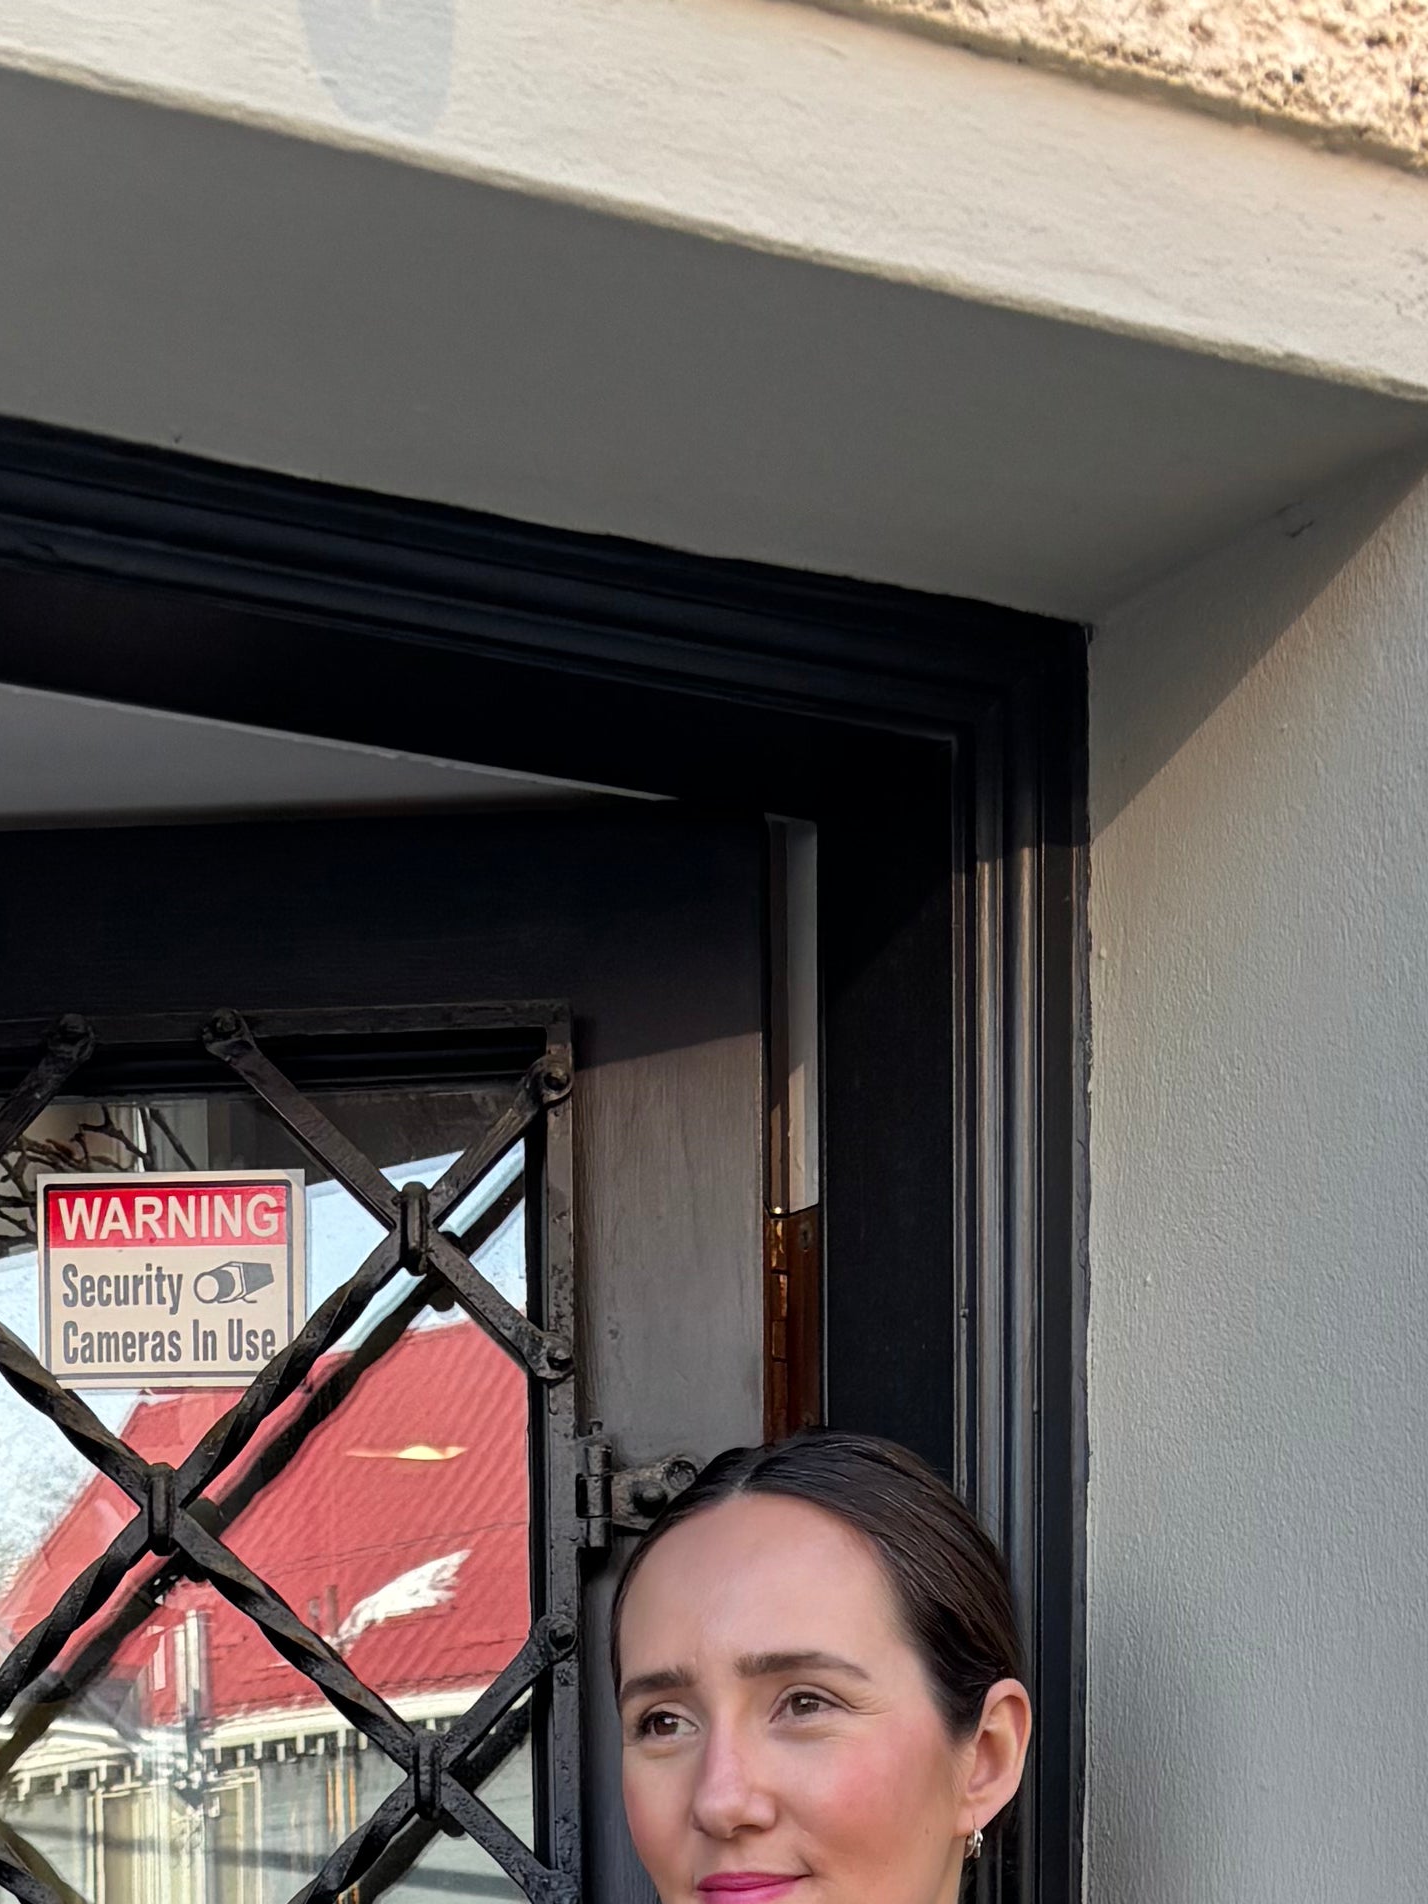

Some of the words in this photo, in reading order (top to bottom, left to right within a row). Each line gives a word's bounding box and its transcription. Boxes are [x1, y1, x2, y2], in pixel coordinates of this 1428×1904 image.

[57, 1192, 280, 1241] WARNING
[61, 1262, 184, 1316] Security
[62, 1320, 183, 1365] Cameras
[191, 1318, 218, 1362] In
[227, 1318, 277, 1362] Use
